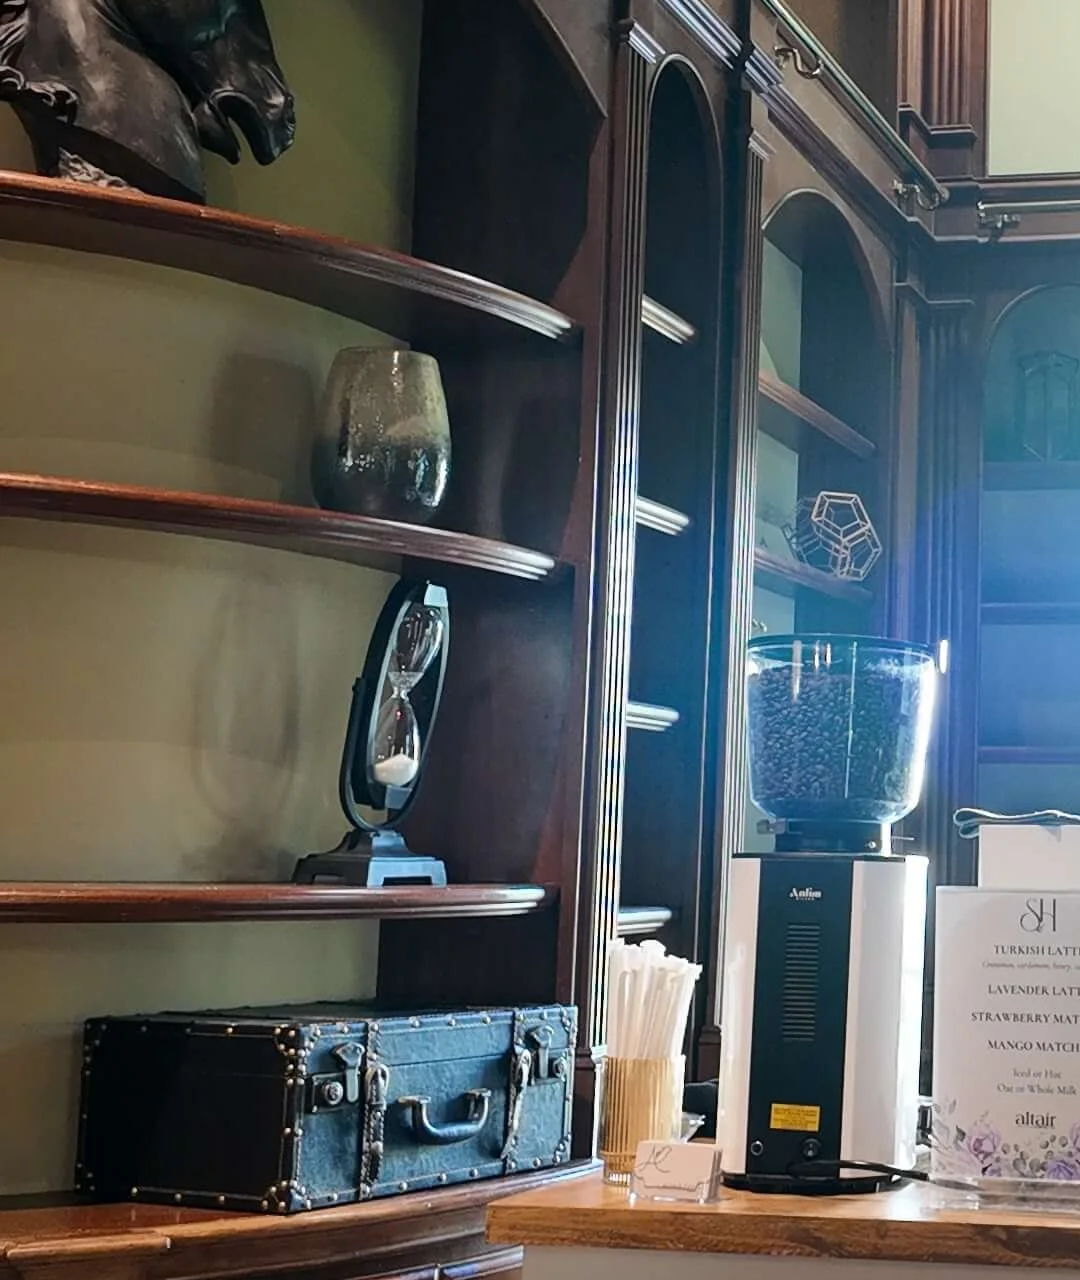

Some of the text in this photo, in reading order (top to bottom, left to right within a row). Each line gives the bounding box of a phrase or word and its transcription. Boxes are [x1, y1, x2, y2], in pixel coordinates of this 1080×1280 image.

[994, 944, 1045, 956] TURKISH
[988, 984, 1049, 996] LAVENDER
[971, 1011, 1051, 1023] STRAWBERRY
[987, 1039, 1033, 1051] MANGO
[1014, 1111, 1057, 1128] altair
